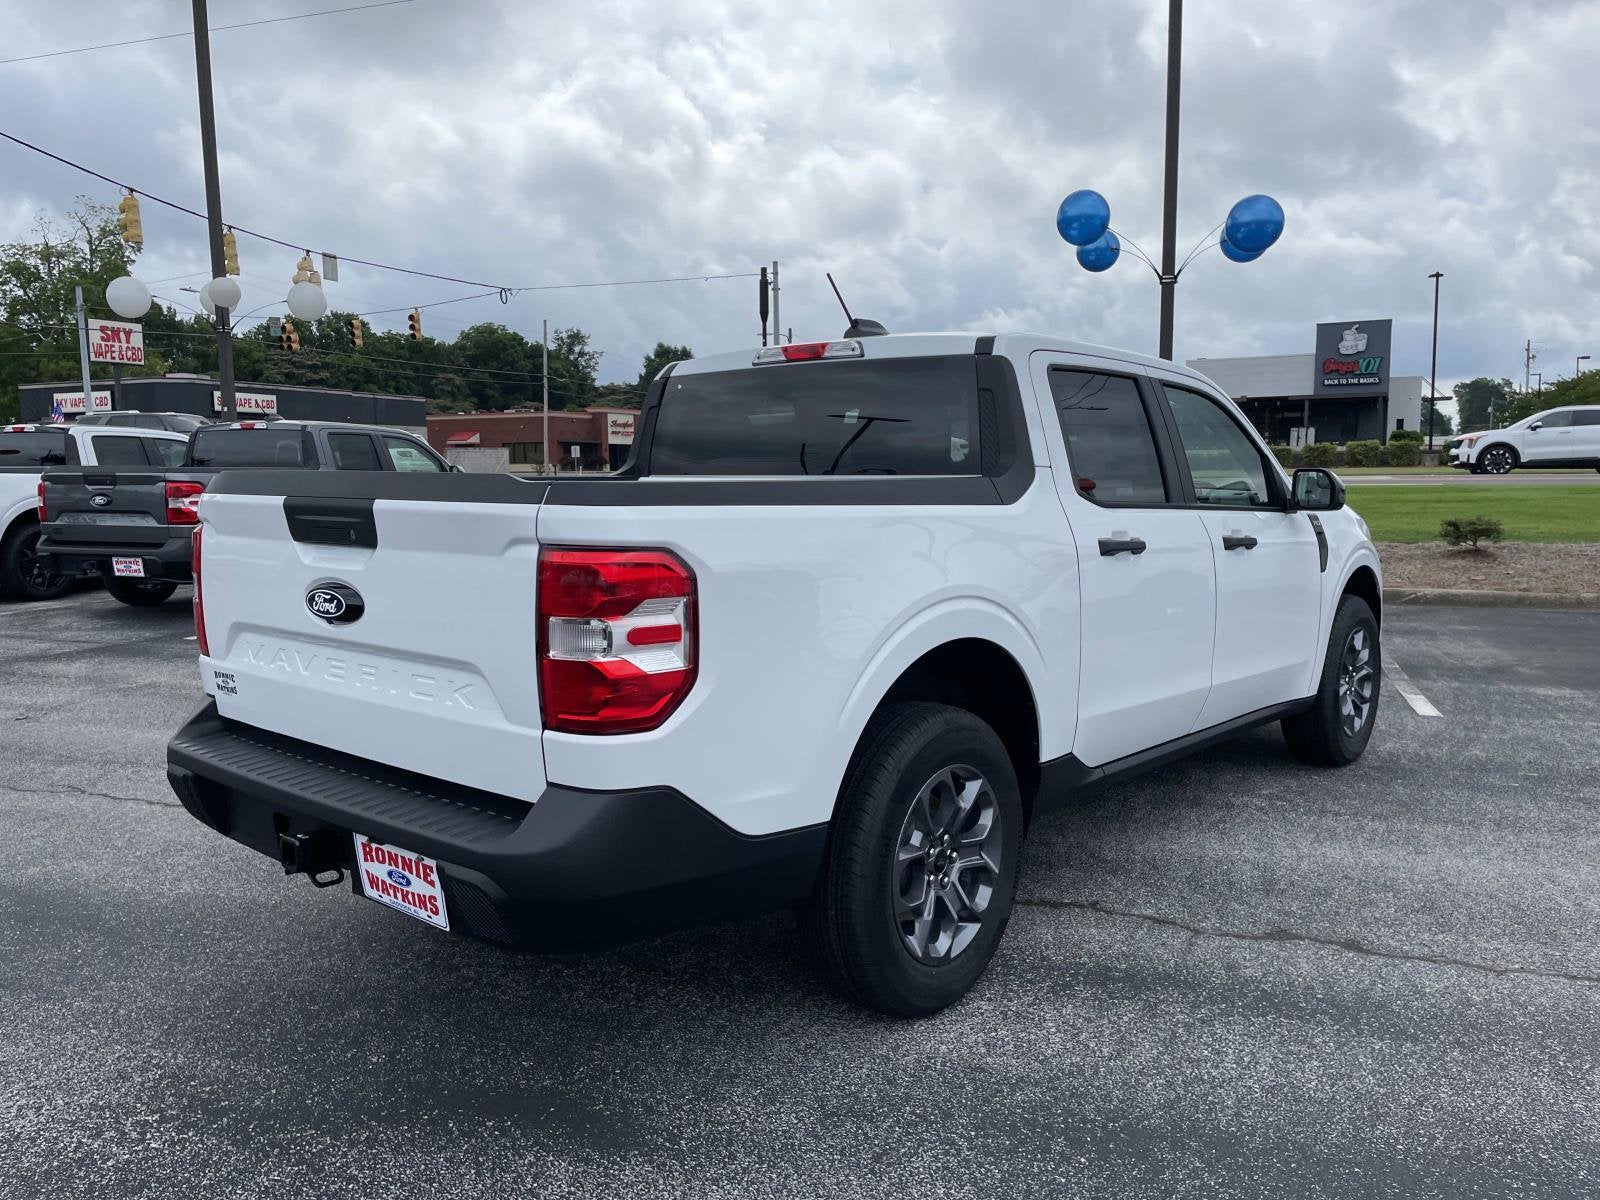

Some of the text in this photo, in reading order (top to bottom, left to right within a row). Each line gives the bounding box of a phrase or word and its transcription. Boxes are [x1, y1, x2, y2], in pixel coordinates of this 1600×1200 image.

[99, 325, 132, 344] SKY
[92, 342, 143, 362] VAPE & CBD
[1355, 357, 1381, 374] 101
[70, 397, 86, 408] VAPE
[94, 396, 109, 407] CBD
[261, 399, 275, 409] CBD
[313, 592, 337, 613] Ford
[361, 841, 436, 889] RONNIE
[365, 868, 440, 916] WATKINS
